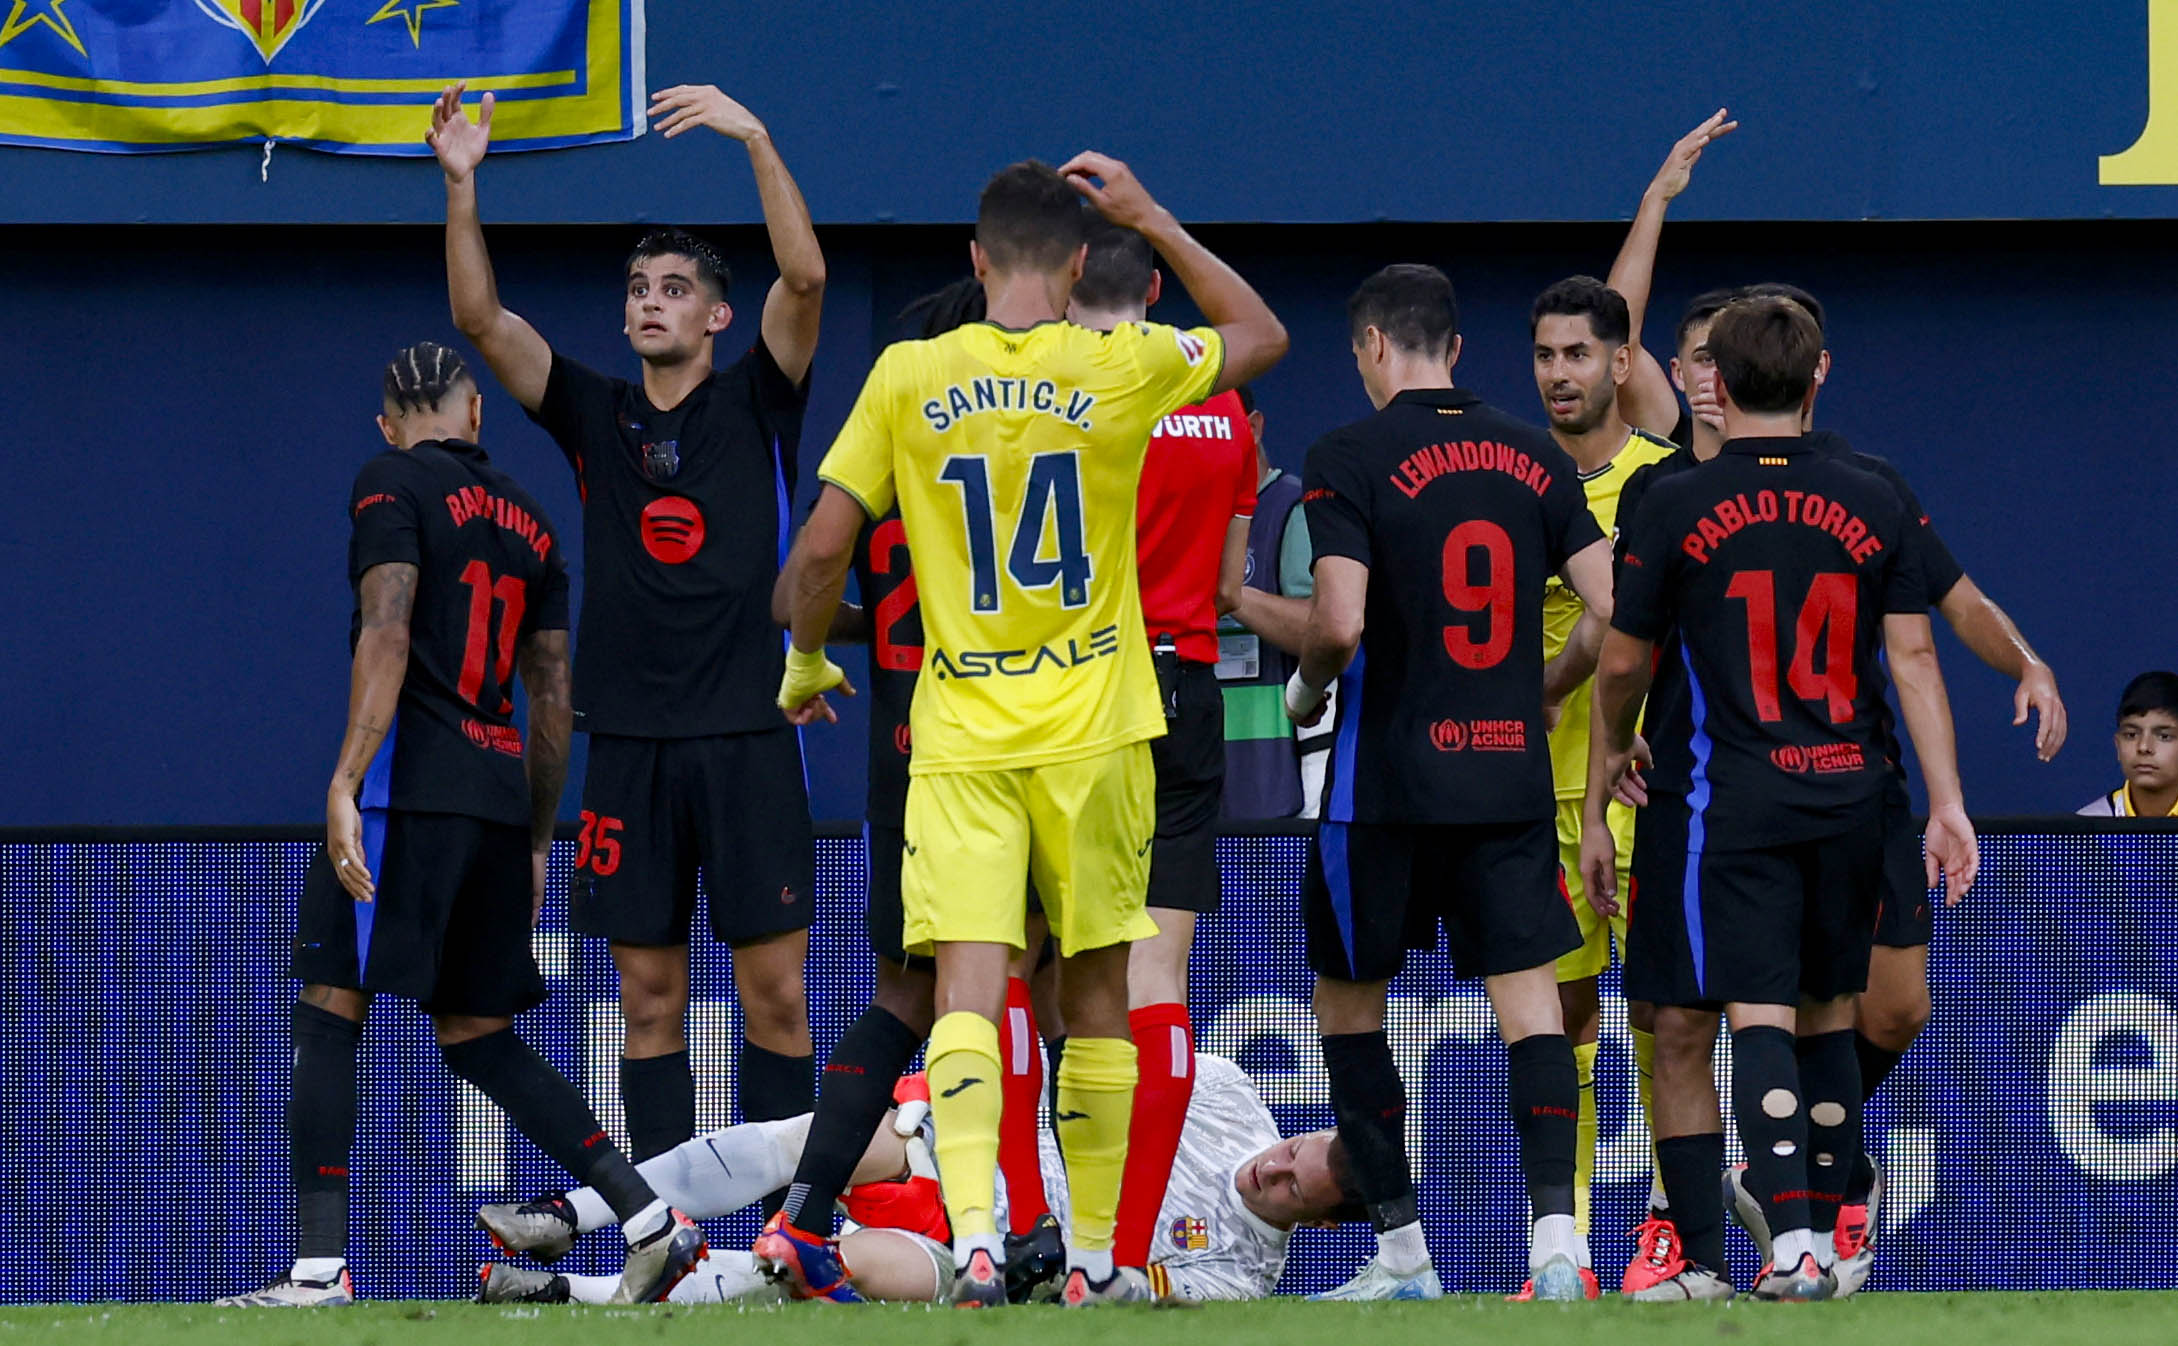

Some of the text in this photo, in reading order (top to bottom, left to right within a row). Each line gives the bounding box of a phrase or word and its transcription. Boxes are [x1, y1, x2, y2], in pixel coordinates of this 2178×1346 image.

[1389, 440, 1553, 499] LEWANDOWSKI
[936, 449, 1096, 614] 14
[1681, 489, 1884, 565] PABLO TORRE
[1442, 519, 1517, 671] 9
[456, 559, 526, 714] 11
[931, 624, 1120, 680] ASCALE
[1723, 569, 1859, 724] 14
[1470, 719, 1525, 734] UNHCR
[1470, 733, 1526, 747] ACNUR
[575, 809, 625, 876] 35
